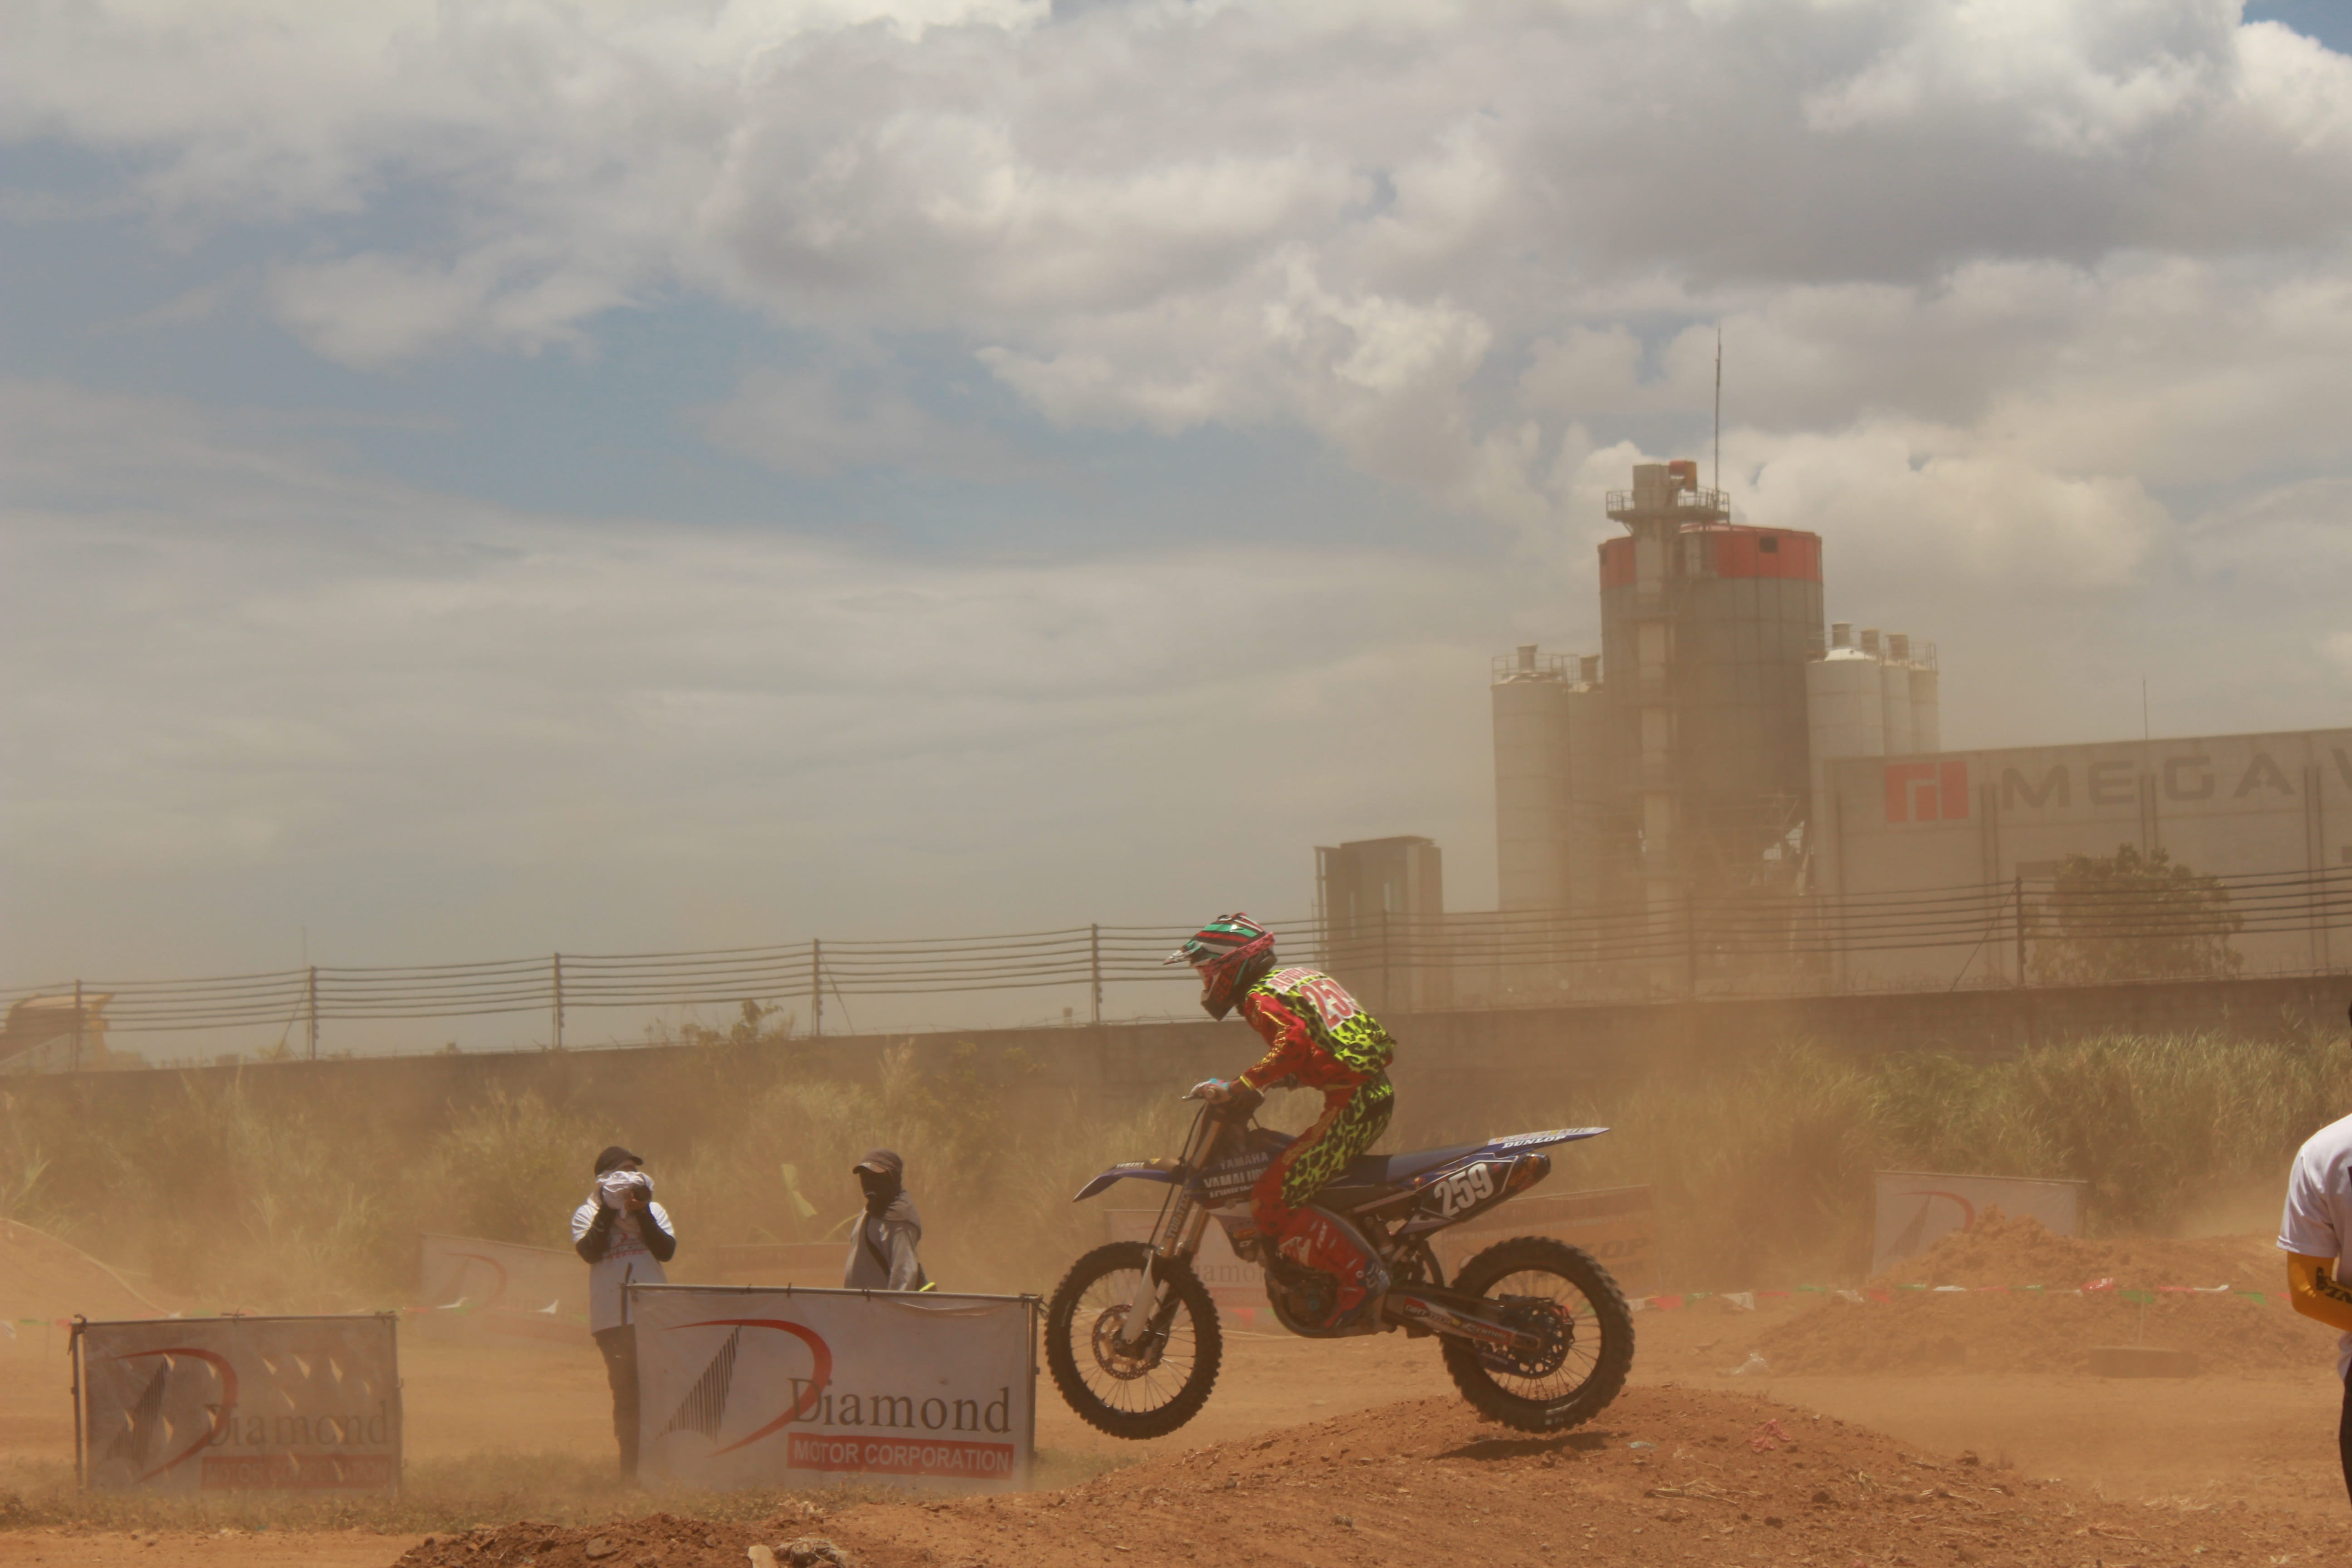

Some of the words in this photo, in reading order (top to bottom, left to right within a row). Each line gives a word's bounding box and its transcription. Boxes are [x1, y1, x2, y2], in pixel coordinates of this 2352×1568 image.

[2002, 752, 2296, 811] MEGA
[1220, 1152, 1269, 1170] YAMAHA
[1502, 1136, 1566, 1149] DUNLOP
[1433, 1163, 1494, 1218] 259
[204, 1400, 389, 1446] Diamond
[787, 1377, 1012, 1434] Diamond
[794, 1440, 859, 1464] MOTOR
[864, 1444, 1009, 1473] CORPORATION
